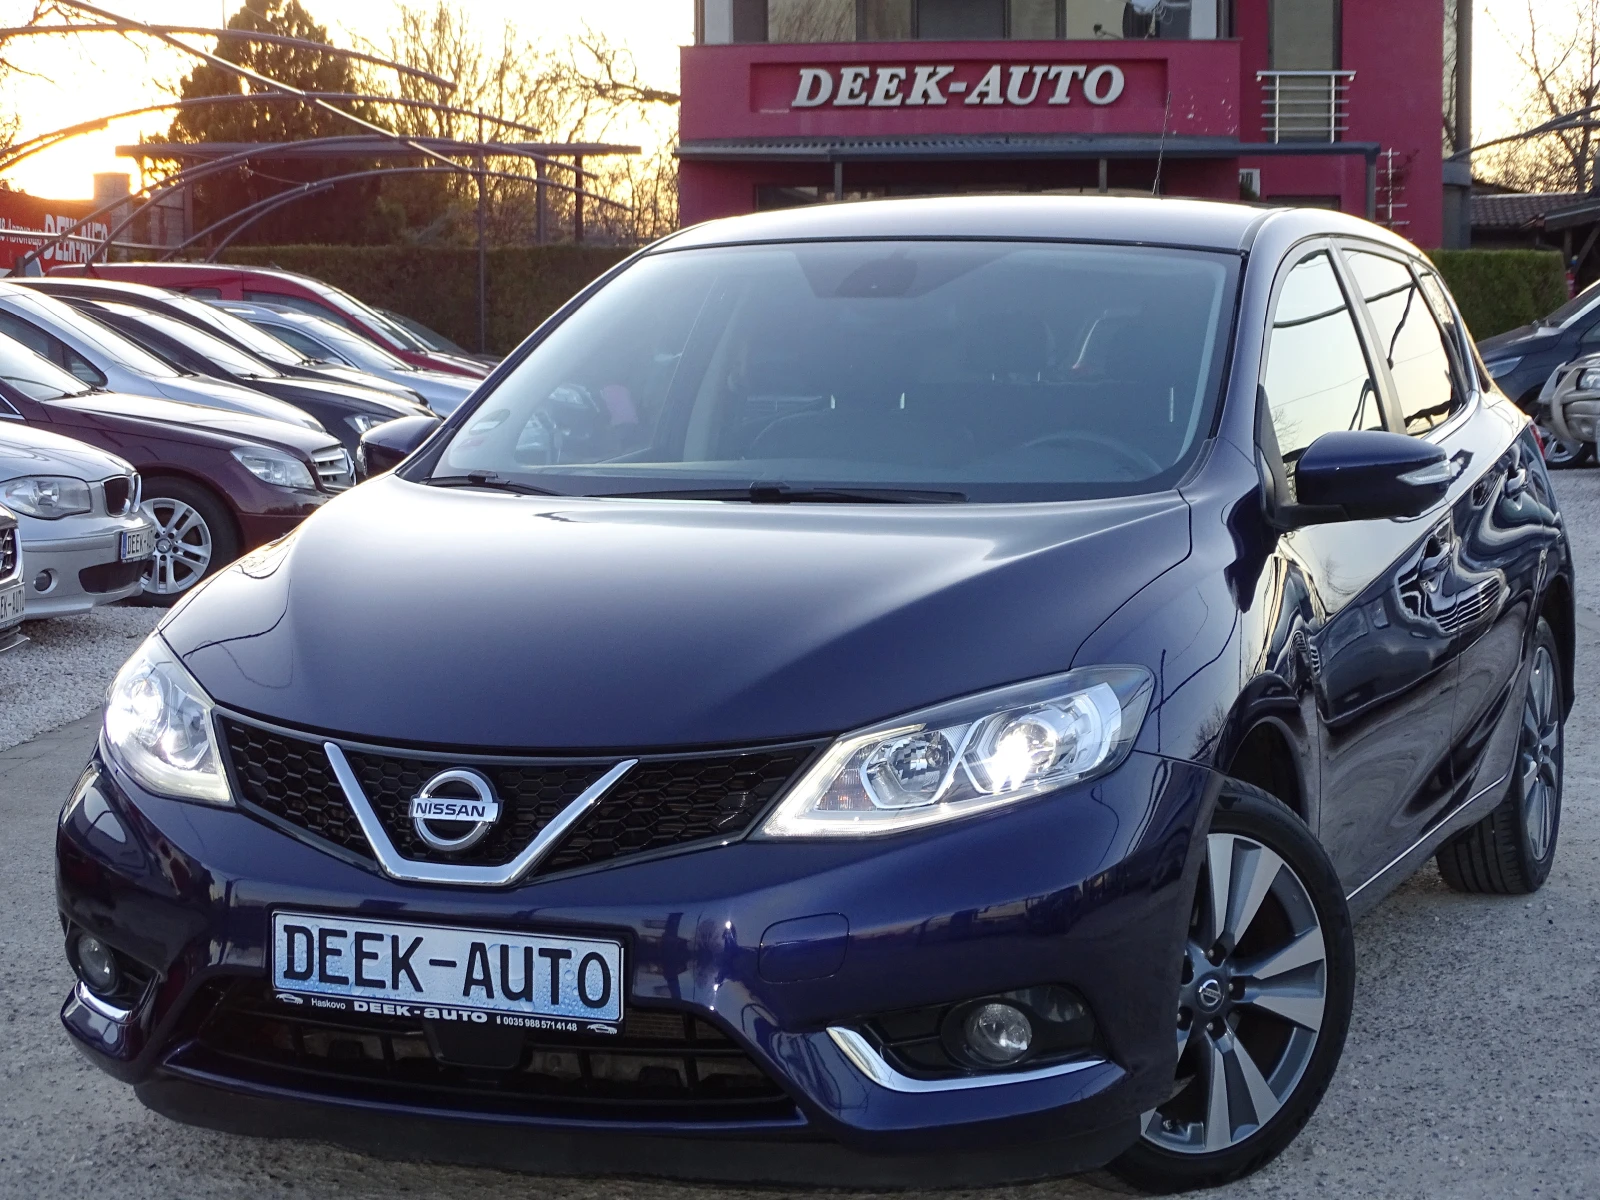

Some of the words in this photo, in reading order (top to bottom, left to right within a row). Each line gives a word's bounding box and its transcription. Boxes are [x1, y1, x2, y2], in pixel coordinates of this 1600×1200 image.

[791, 64, 1125, 107] DEEK-AUTO
[43, 213, 108, 264] DEEK-AUTO
[415, 802, 486, 818] NISSAN
[283, 924, 612, 1009] DEEK-AUTO
[311, 998, 346, 1010] Haskovo
[503, 1016, 524, 1026] 0035
[524, 1018, 540, 1028] 988
